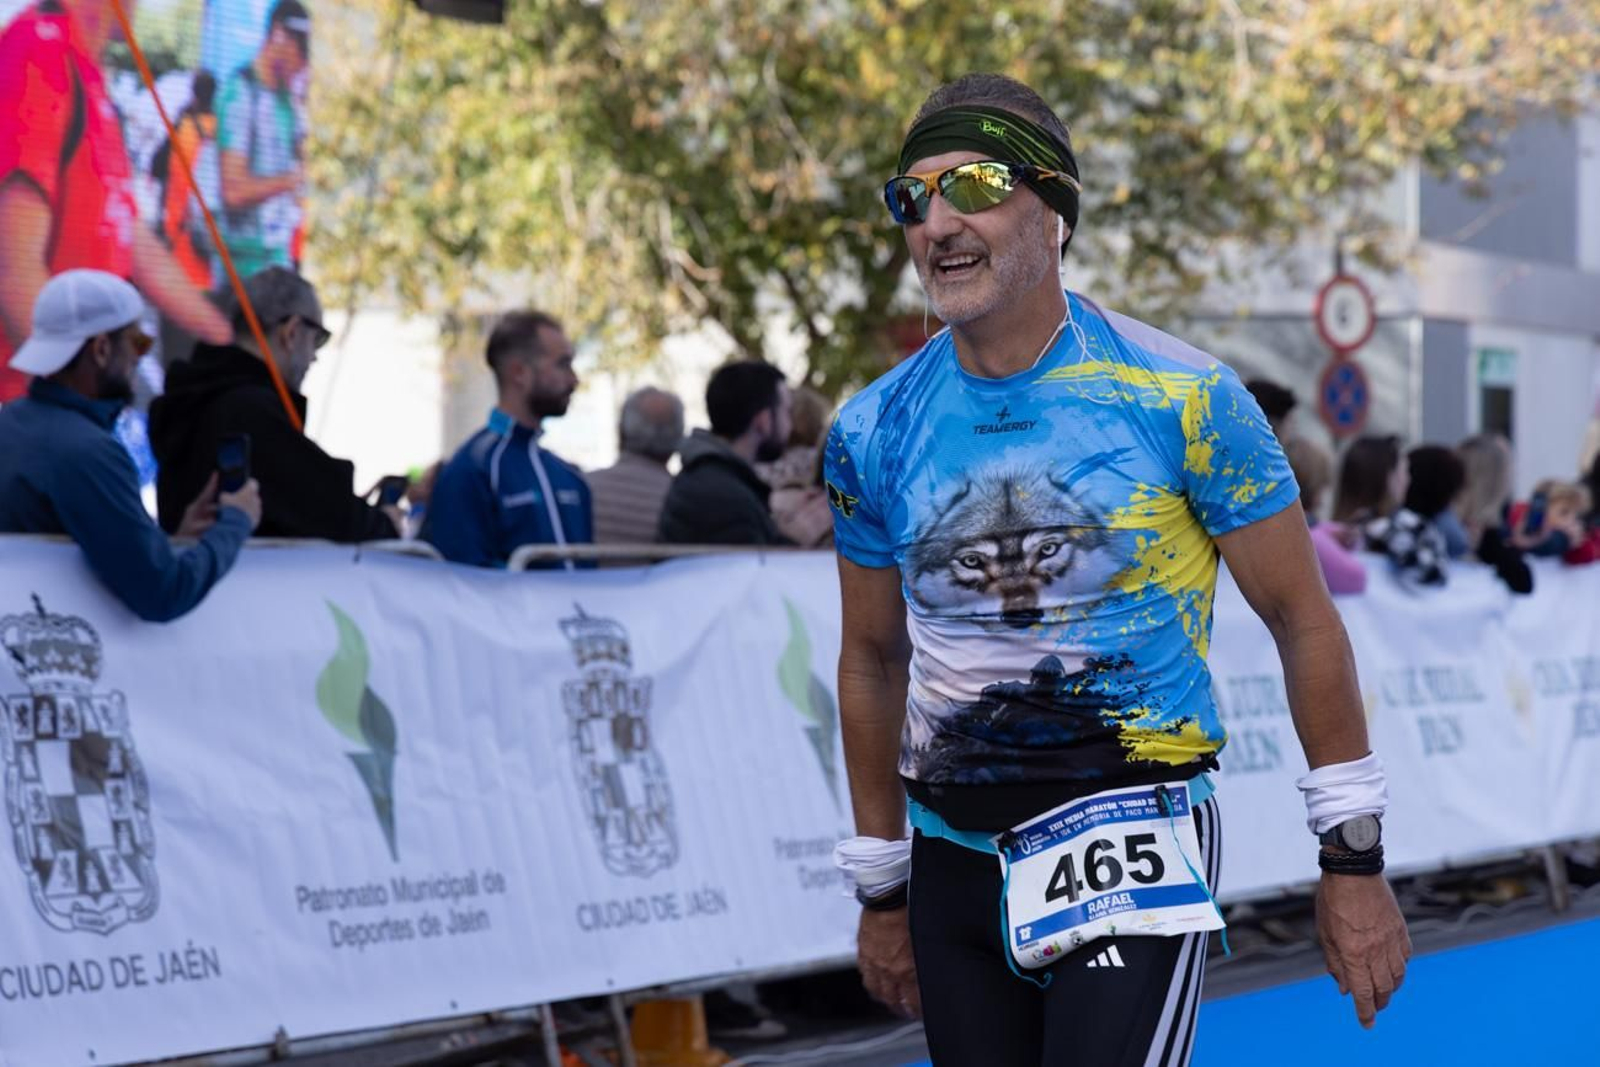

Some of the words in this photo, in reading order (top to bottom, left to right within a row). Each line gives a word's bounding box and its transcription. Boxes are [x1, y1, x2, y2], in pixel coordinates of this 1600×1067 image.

[974, 420, 1038, 434] TEAMERGY
[1064, 810, 1085, 825] MEDIA
[1085, 801, 1118, 815] MARATÓN
[1083, 811, 1110, 826] MEMORIA
[1113, 809, 1122, 818] DE
[1125, 808, 1142, 817] PACO
[1045, 832, 1165, 904] 465
[295, 885, 388, 913] Patronato
[391, 869, 479, 905] Municipal
[481, 868, 506, 895] de
[1087, 892, 1135, 914] RAFAEL
[328, 915, 416, 953] Deportes
[418, 909, 443, 939] de
[0, 958, 104, 1001] CIUDAD
[109, 954, 148, 989] DE
[155, 938, 222, 985] JAÉN
